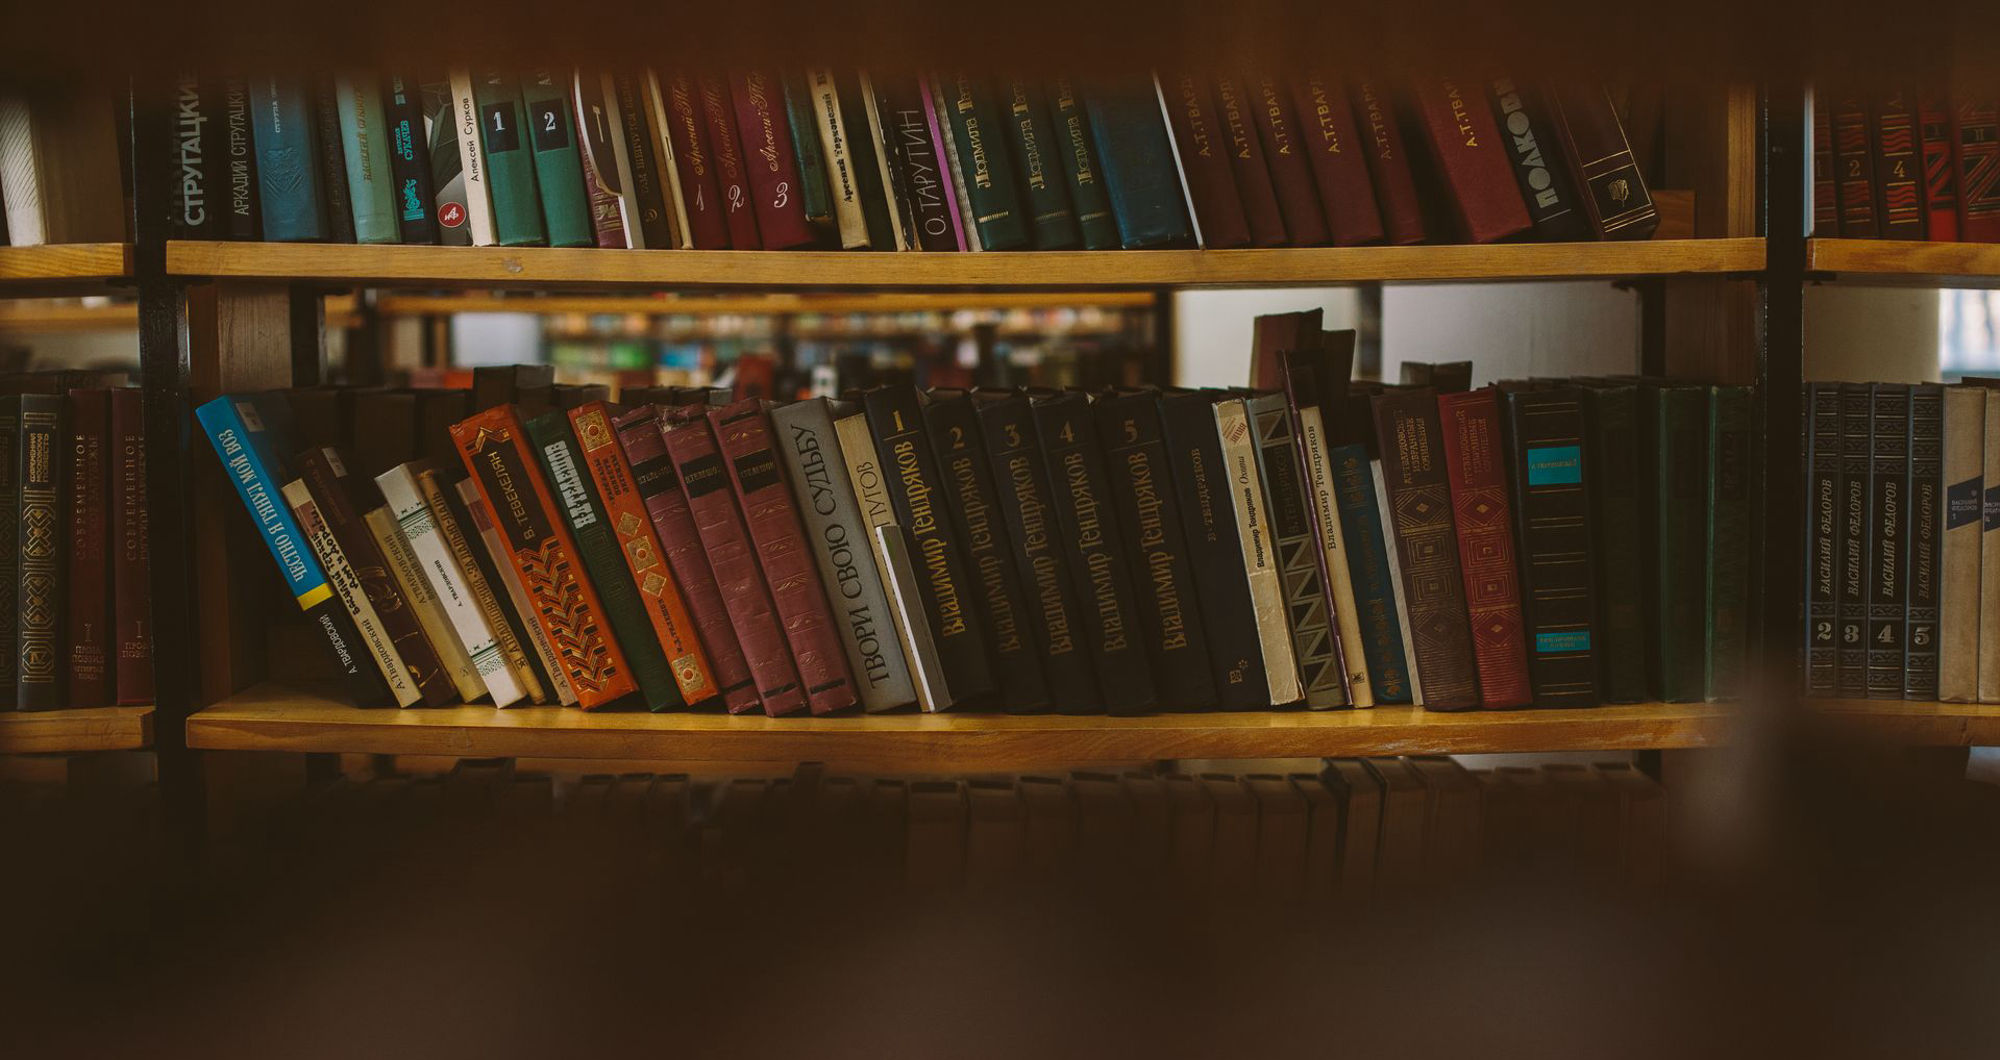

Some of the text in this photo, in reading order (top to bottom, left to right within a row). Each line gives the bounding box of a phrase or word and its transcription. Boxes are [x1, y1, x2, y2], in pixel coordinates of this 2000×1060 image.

[463, 97, 483, 182] Алексей Сурков
[493, 112, 506, 131] 1
[544, 112, 556, 131] 2
[678, 108, 704, 175] Арсений
[756, 101, 780, 172] Арсений
[1066, 115, 1094, 186] Людмила
[896, 108, 947, 237] О. ТАРУТИН
[964, 116, 992, 190] Людмила
[1019, 118, 1046, 191] Людмила
[1849, 159, 1862, 177] 2
[1892, 160, 1906, 178] 4
[231, 158, 249, 217] АРКАДИЙ
[728, 184, 745, 213] 2
[773, 181, 789, 209] 3
[217, 428, 242, 456] ВОЗ
[892, 409, 906, 434] 1
[949, 425, 966, 450] 2
[1003, 424, 1022, 448] 3
[1059, 420, 1075, 443] 4
[1124, 418, 1139, 443] 5
[75, 433, 87, 561] СОВРЕМЕННОЕ
[125, 435, 137, 561] СОВРЕМЕННОЕ
[227, 453, 258, 485] МОЙ
[486, 449, 536, 541] В. ТЕВЕКЕЛЯН
[1307, 425, 1337, 551] Владимир Тендряков
[246, 482, 279, 525] ТЯНУЛ
[268, 522, 285, 536] Я
[273, 533, 309, 583] ЧЕСТНО
[790, 418, 892, 690] ТВОРИ СВОЮ СУДЬБУ
[892, 439, 967, 638] Владимир Тендряков
[951, 455, 1023, 655] Владимир Тендряков
[1009, 455, 1074, 656] Владимир Тендряков
[1063, 452, 1128, 654] Владимир Тендряков
[1127, 452, 1187, 652] Владимир Тендряков
[1820, 479, 1833, 594] ВАСИЛИЙ ФЕДОРОВ
[1847, 480, 1863, 597] ВАСИЛИЙ ФЕДОРОВ
[1882, 481, 1898, 598] ВАСИЛИЙ ФЕДОРОВ
[1918, 483, 1933, 600] ВАСИЛИЙ ФЕДОРОВ
[319, 613, 353, 667] ТВАРДОВСКИЙ
[1816, 621, 1832, 641] 2
[1844, 624, 1860, 643] 3
[1877, 624, 1896, 644] 4
[1914, 626, 1931, 646] 5
